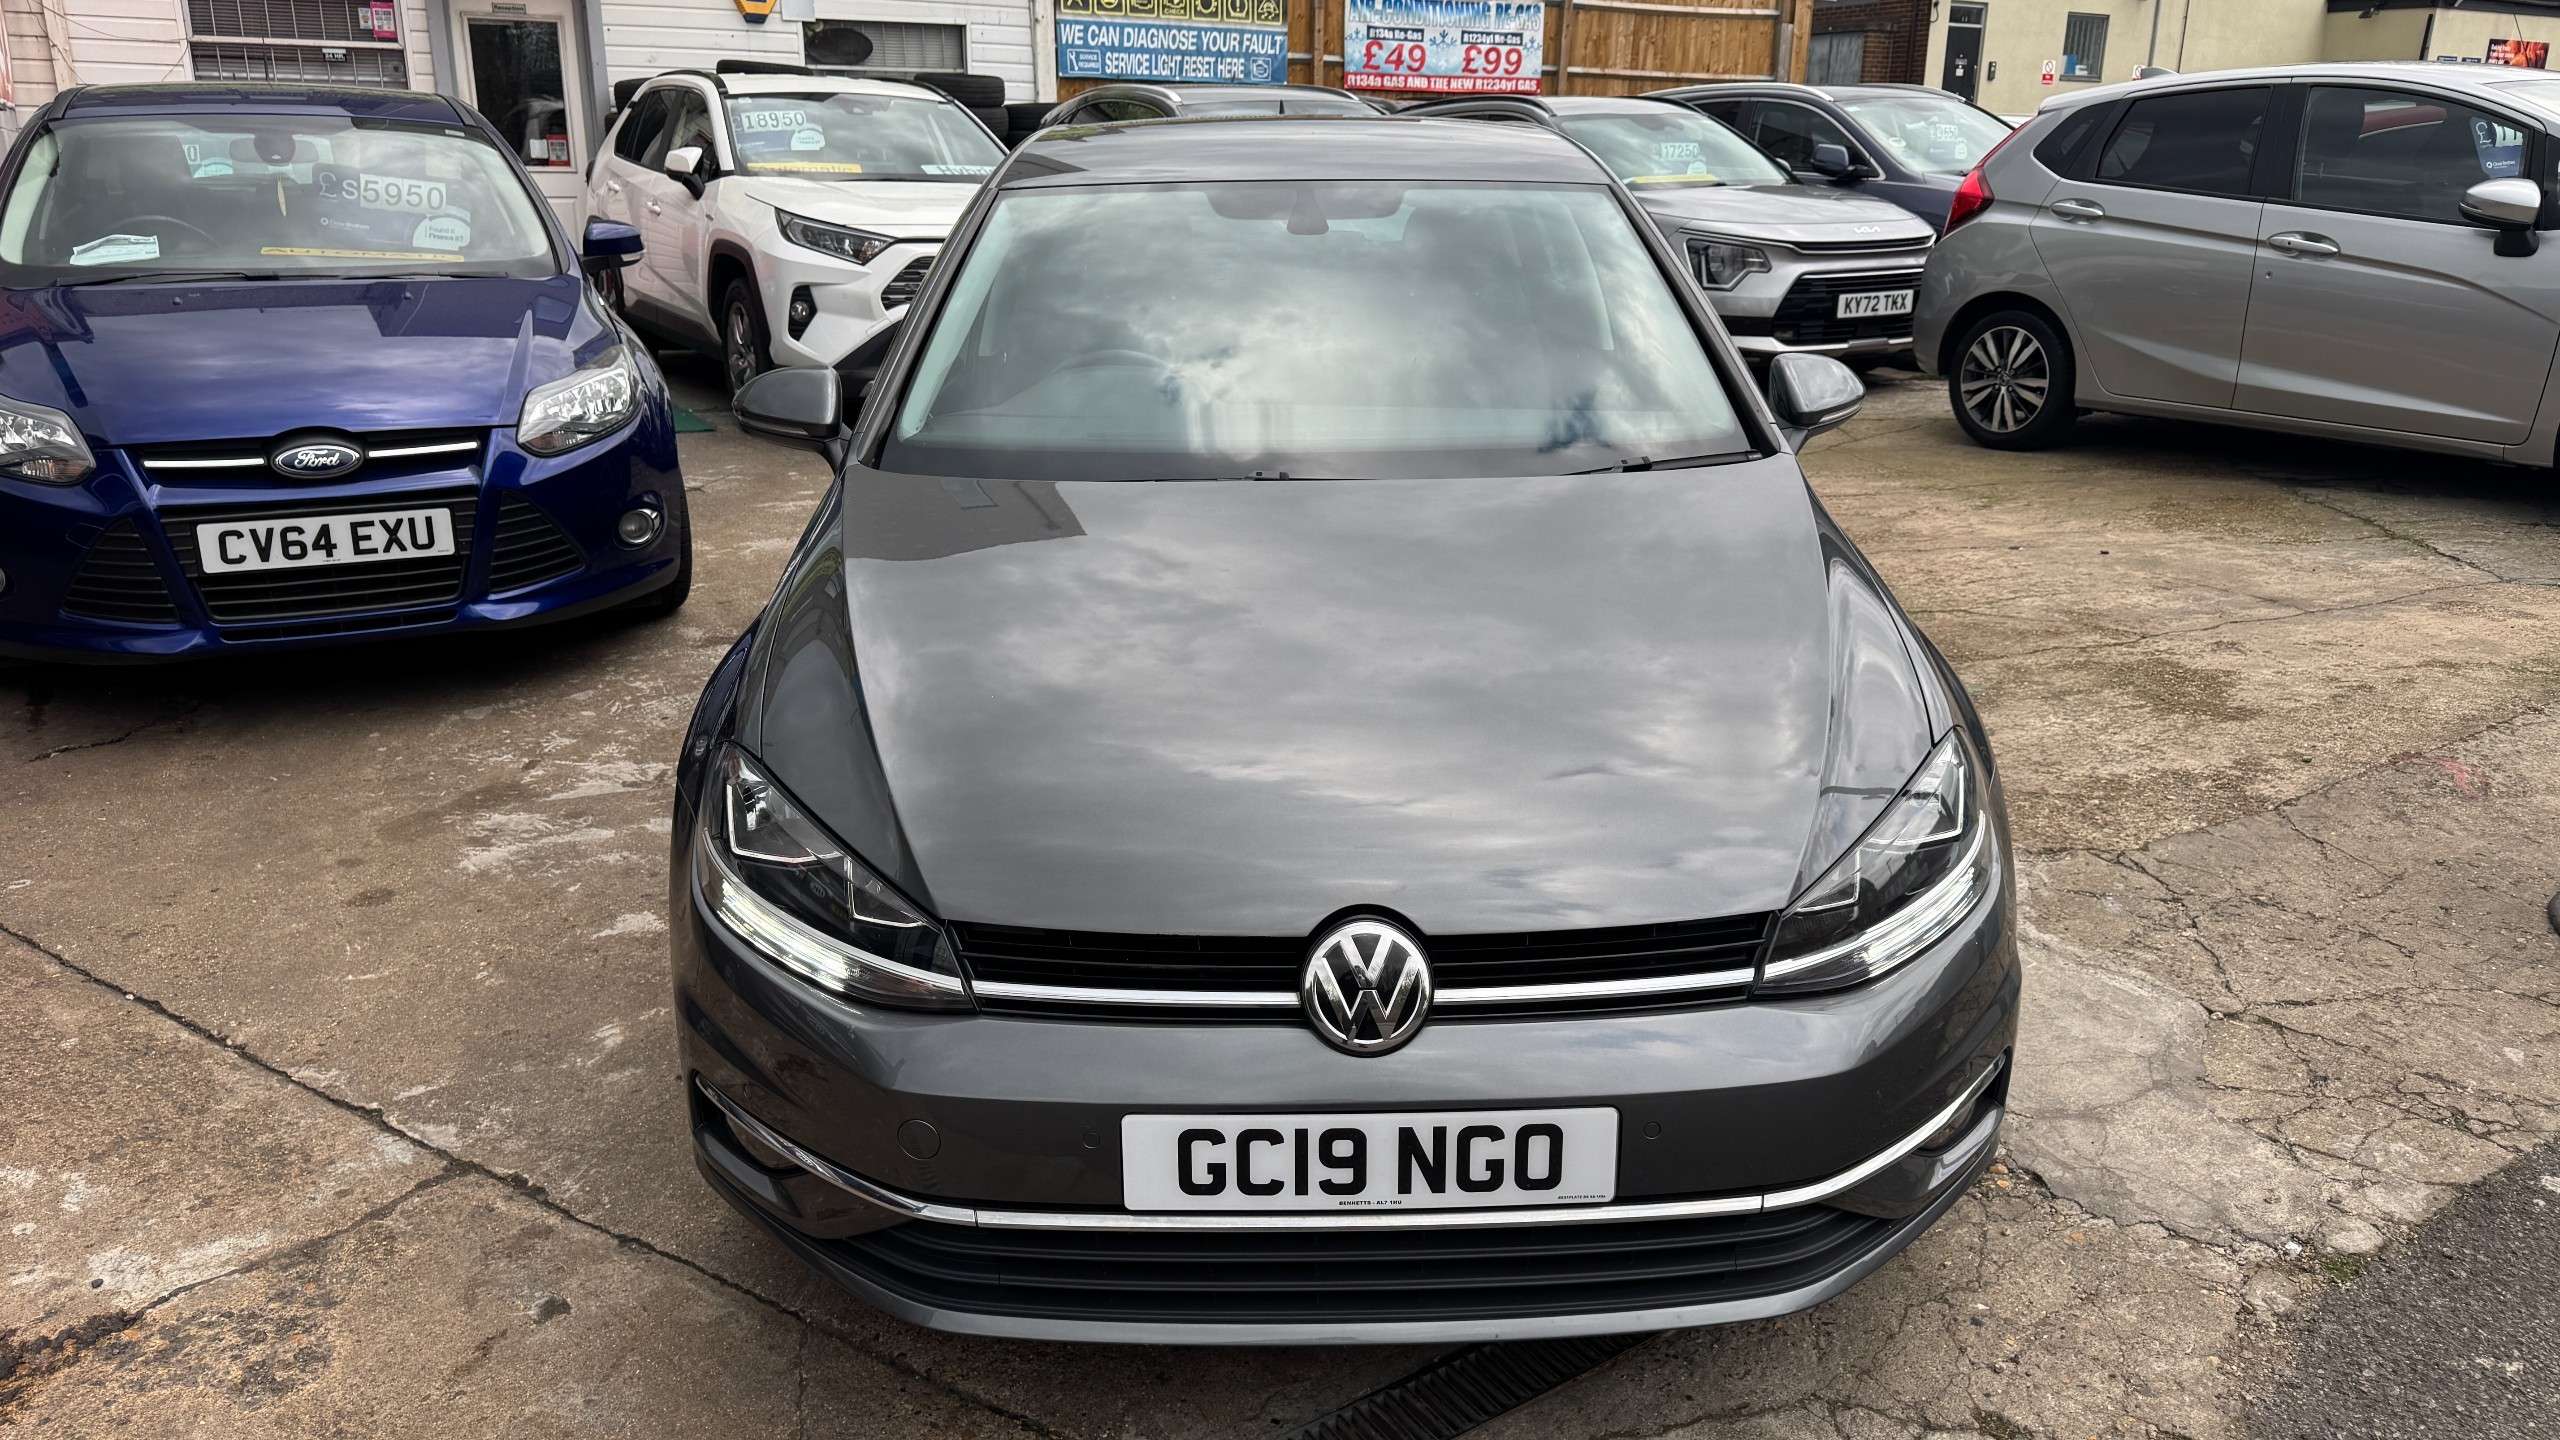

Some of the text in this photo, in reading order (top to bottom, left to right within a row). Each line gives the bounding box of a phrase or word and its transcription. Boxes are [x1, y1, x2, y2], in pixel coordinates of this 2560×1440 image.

[1350, 0, 1541, 31] AIR-CONDITIONING RE-GAS
[1061, 23, 1283, 54] WE CAN DIAGNOSE YOUR FAULT
[1369, 27, 1422, 41] R134a Re-Gas
[1494, 34, 1521, 45] Re-Gas
[1105, 51, 1245, 79] SERVICE LIGHT RESET HERE
[1362, 40, 1427, 73] £49
[1461, 44, 1523, 75] £99
[1347, 74, 1382, 87] R134a
[1383, 76, 1405, 88] GAS
[1406, 76, 1429, 89] AND
[1430, 77, 1449, 90] THE
[1450, 78, 1475, 91] NEW
[1475, 79, 1517, 92] R1234yf
[1844, 293, 1908, 314] KY72 TKX
[294, 449, 340, 470] Ford
[217, 515, 436, 565] CV64 EXU
[1177, 1123, 1564, 1197] GC19 NGO
